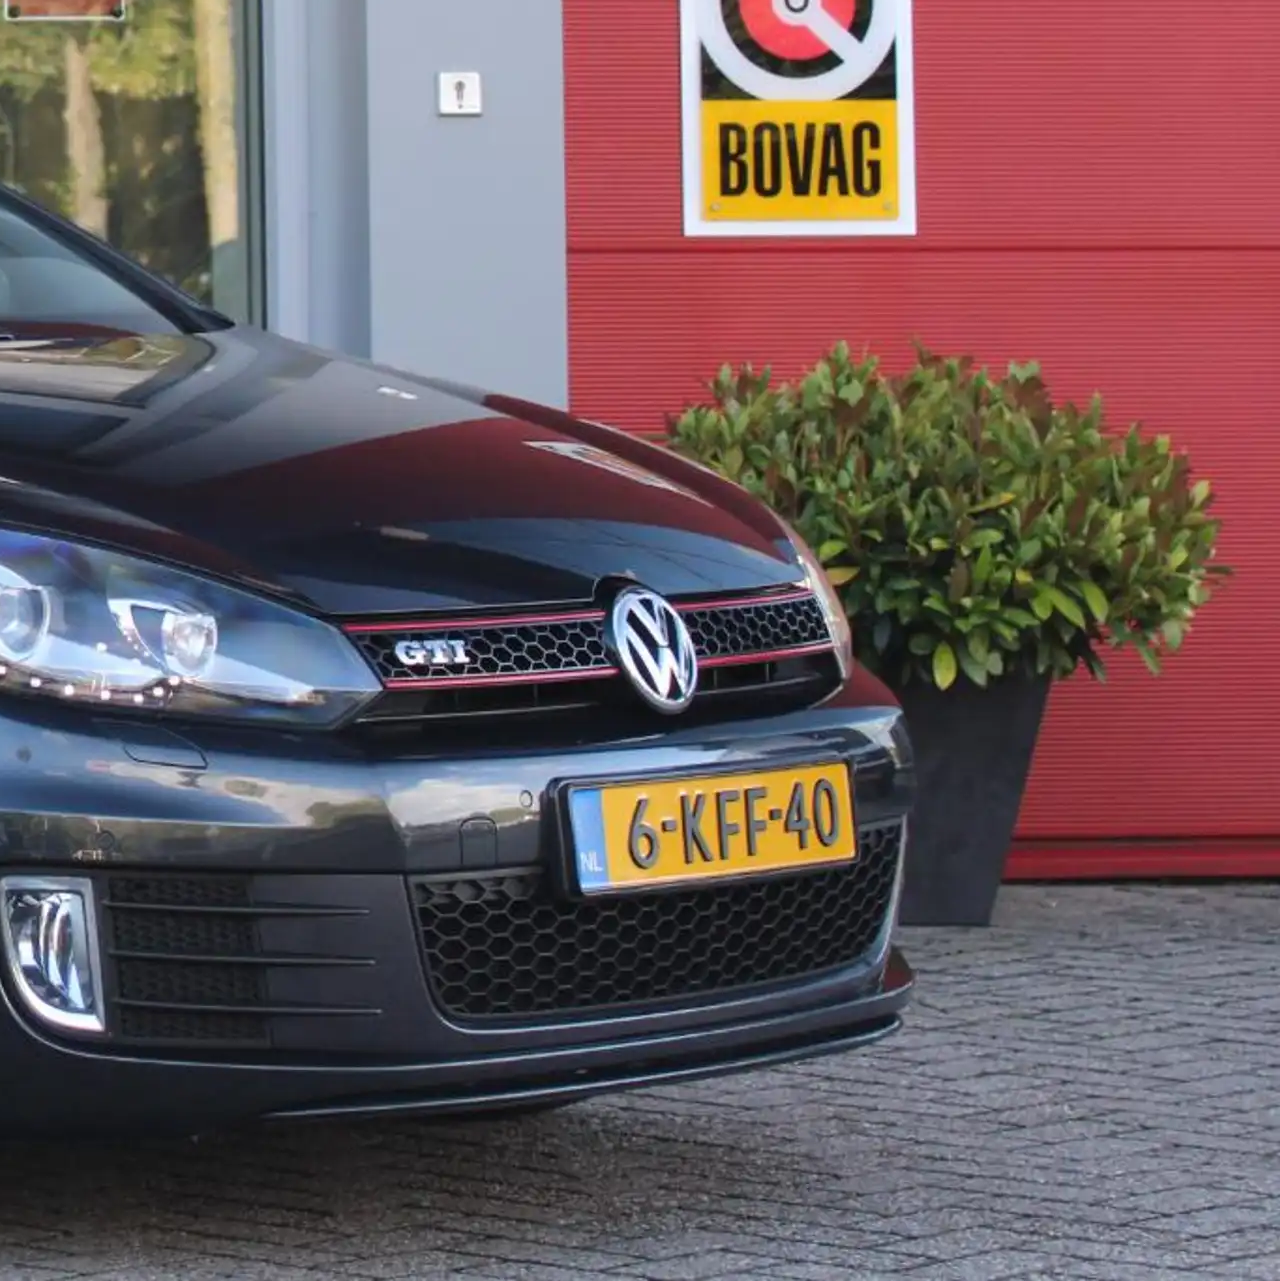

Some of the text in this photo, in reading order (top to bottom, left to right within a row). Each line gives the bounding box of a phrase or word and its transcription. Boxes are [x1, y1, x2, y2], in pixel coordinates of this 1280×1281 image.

[719, 120, 881, 197] BOVAG
[394, 639, 471, 666] GTI
[627, 777, 840, 871] 6-KFF-40
[579, 851, 603, 873] NL
